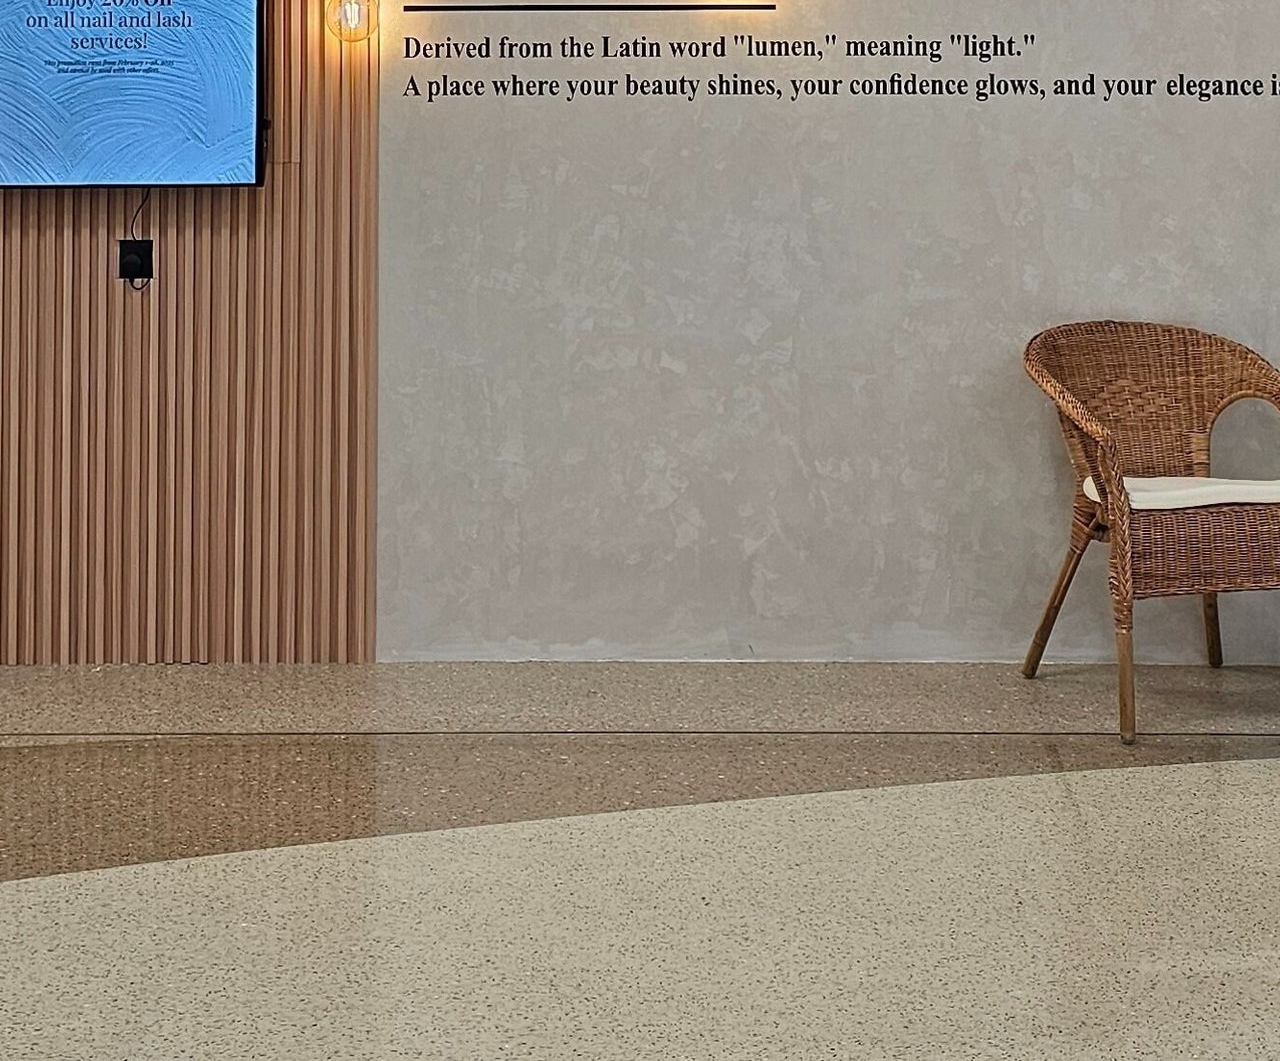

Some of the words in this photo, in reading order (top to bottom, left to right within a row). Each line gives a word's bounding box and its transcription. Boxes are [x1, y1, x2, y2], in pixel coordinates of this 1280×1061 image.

[25, 13, 49, 28] on
[53, 10, 76, 28] all
[80, 11, 114, 28] nail
[119, 10, 152, 28] and
[156, 10, 192, 28] lash
[70, 33, 148, 49] services!
[404, 36, 490, 59] Derived
[498, 36, 552, 59] from
[560, 37, 594, 58] the
[601, 36, 661, 58] Latin
[668, 36, 726, 58] word
[733, 35, 837, 61] "lumen,"
[845, 35, 942, 62] meaning
[950, 34, 1035, 62] "light."
[402, 75, 422, 96] A
[427, 75, 485, 102] place
[491, 75, 560, 96] where
[566, 79, 619, 102] your
[625, 74, 700, 102] beauty
[707, 74, 783, 100] shines,
[790, 79, 843, 102] your
[849, 73, 969, 95] confidence
[975, 74, 1046, 102] glows,
[1053, 74, 1096, 95] and
[1102, 79, 1157, 102] your
[1166, 74, 1264, 102] elegance
